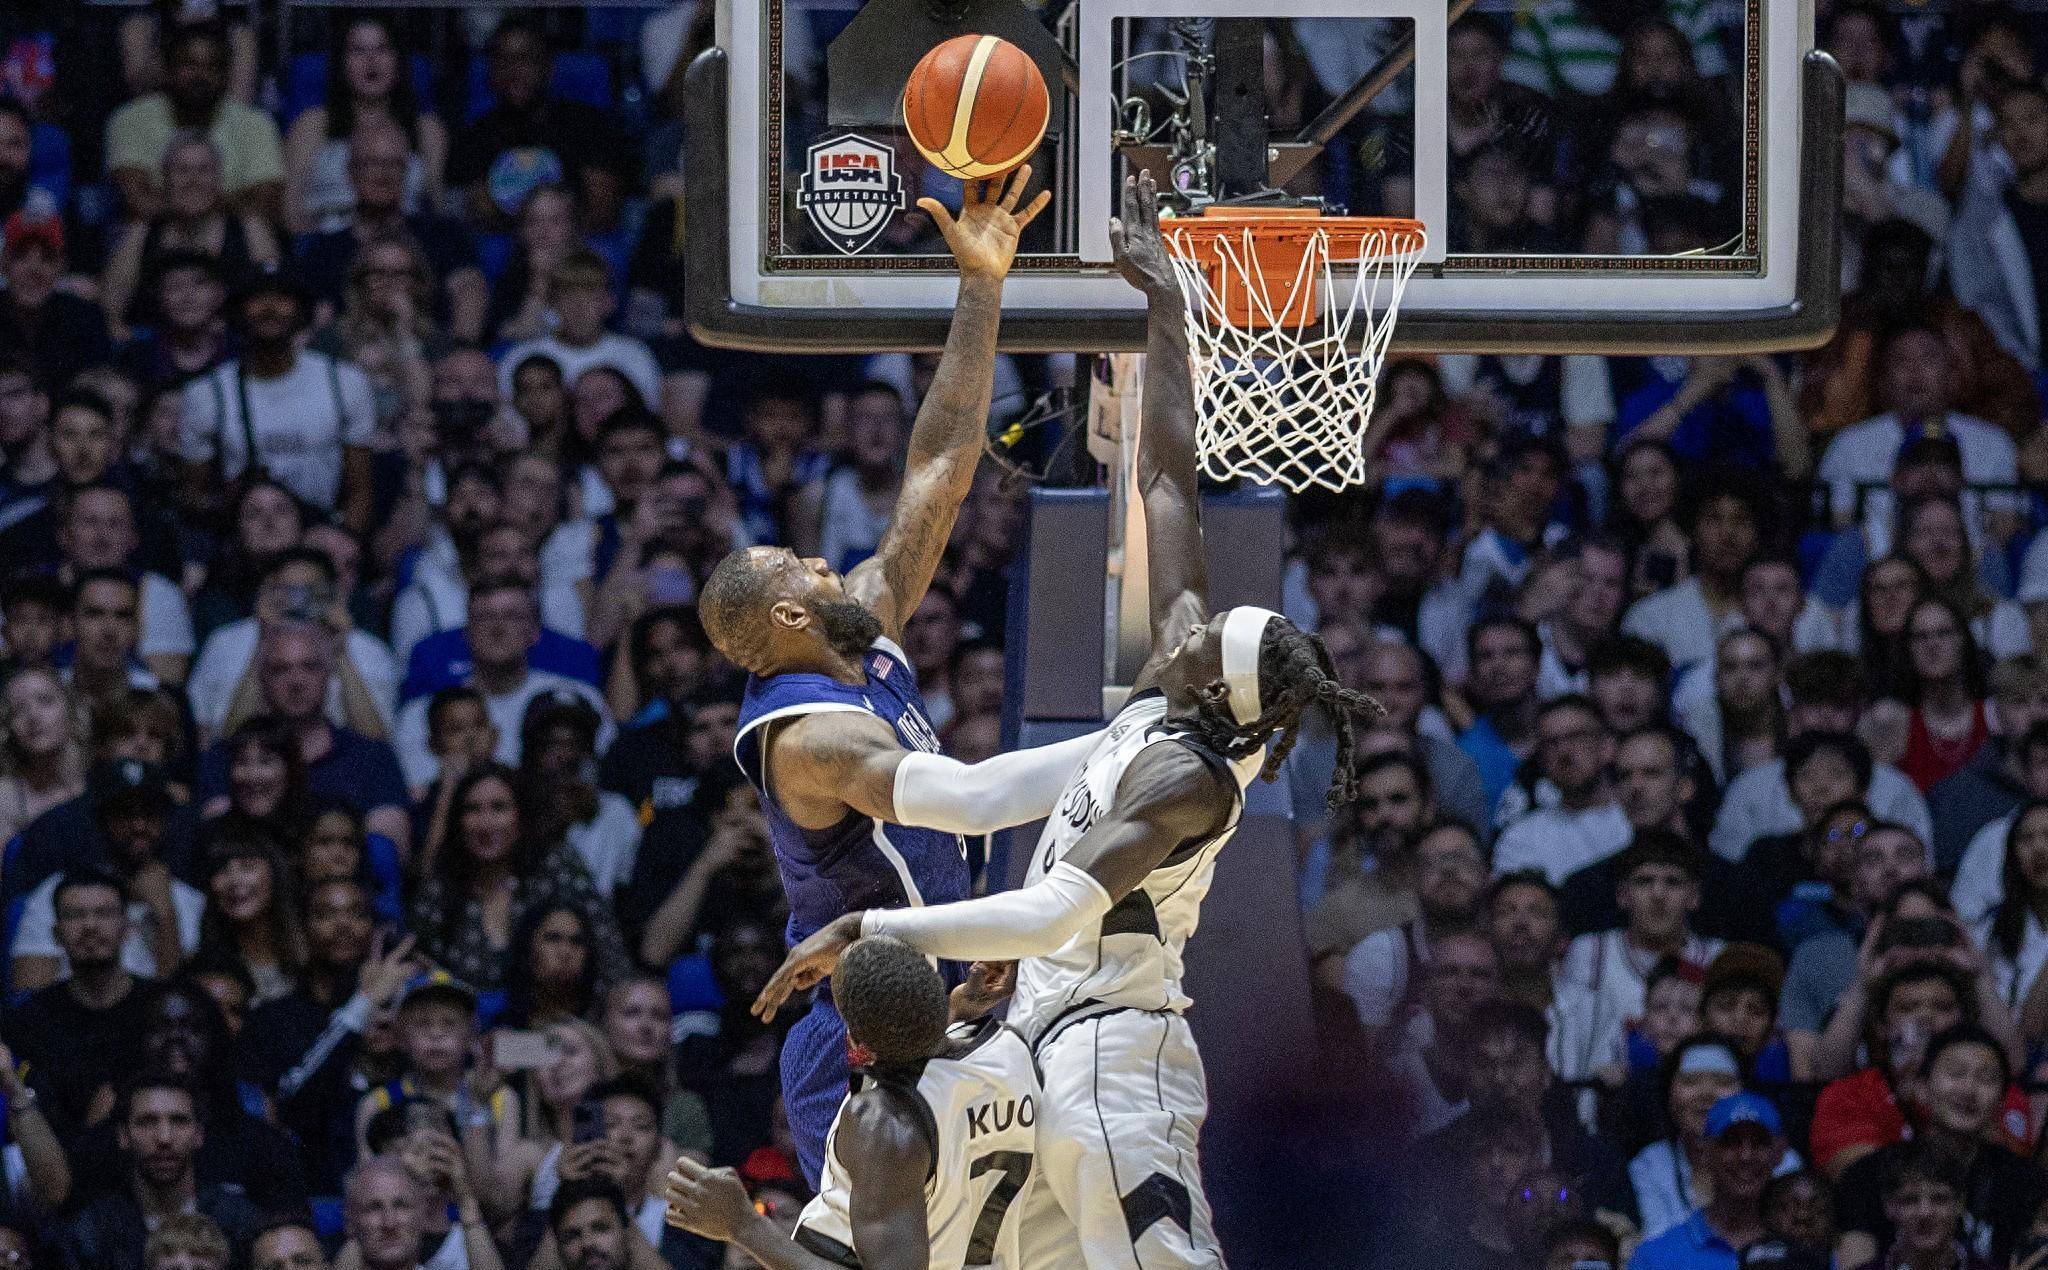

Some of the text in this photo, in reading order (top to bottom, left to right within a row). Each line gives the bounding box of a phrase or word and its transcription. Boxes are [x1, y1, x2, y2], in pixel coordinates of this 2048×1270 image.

[820, 154, 883, 184] USA
[804, 191, 896, 203] BASKETBALL
[964, 1150, 1034, 1266] 7
